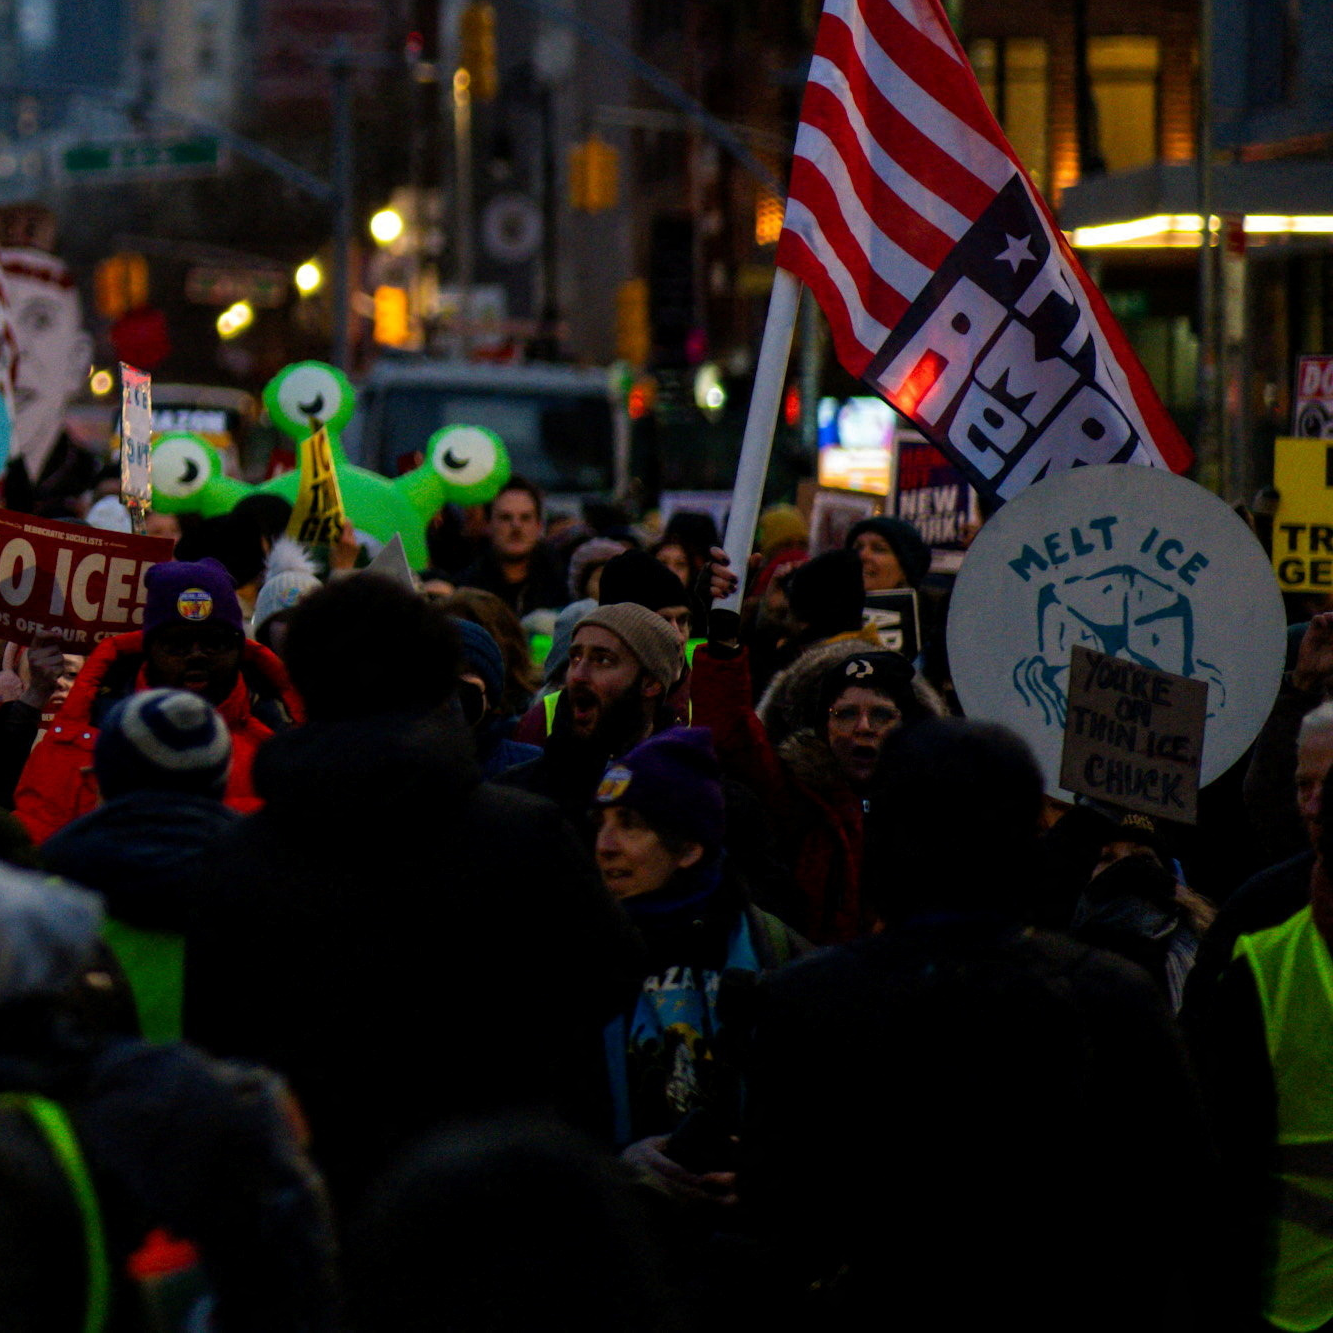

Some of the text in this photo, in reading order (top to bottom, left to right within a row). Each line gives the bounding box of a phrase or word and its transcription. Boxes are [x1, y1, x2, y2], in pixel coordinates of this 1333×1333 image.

[1008, 516, 1210, 586] MELT ICE
[48, 547, 157, 625] ICE!
[1072, 705, 1137, 753] THIN
[1115, 695, 1151, 727] ON
[1084, 753, 1186, 809] CHUCK
